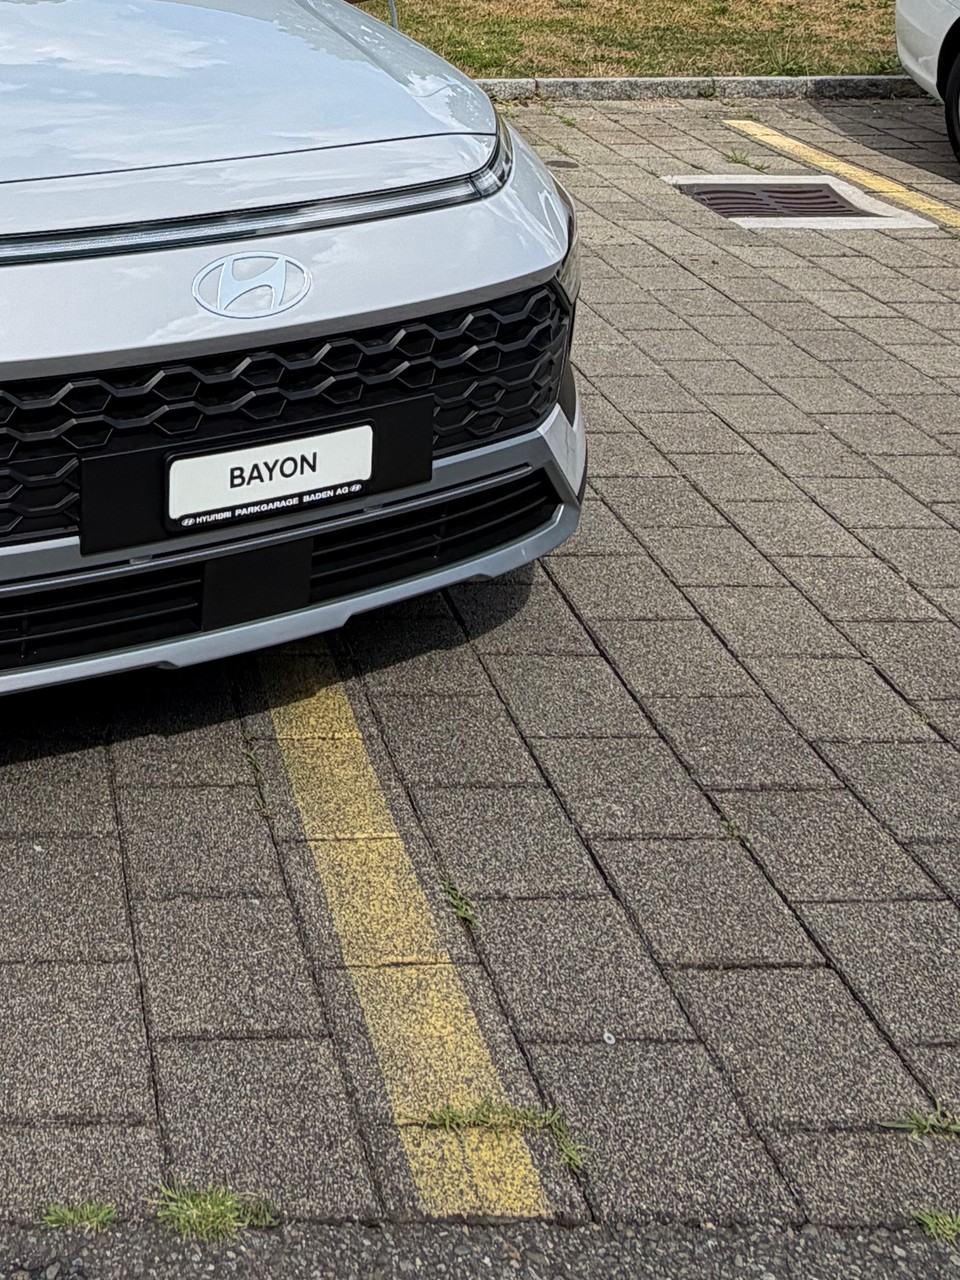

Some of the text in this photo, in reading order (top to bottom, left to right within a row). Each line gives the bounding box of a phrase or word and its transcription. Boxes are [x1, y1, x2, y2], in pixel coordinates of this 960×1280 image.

[230, 452, 317, 489] BAYON
[196, 486, 349, 524] HYUNDAI PARKGARAGE BADEN AG
